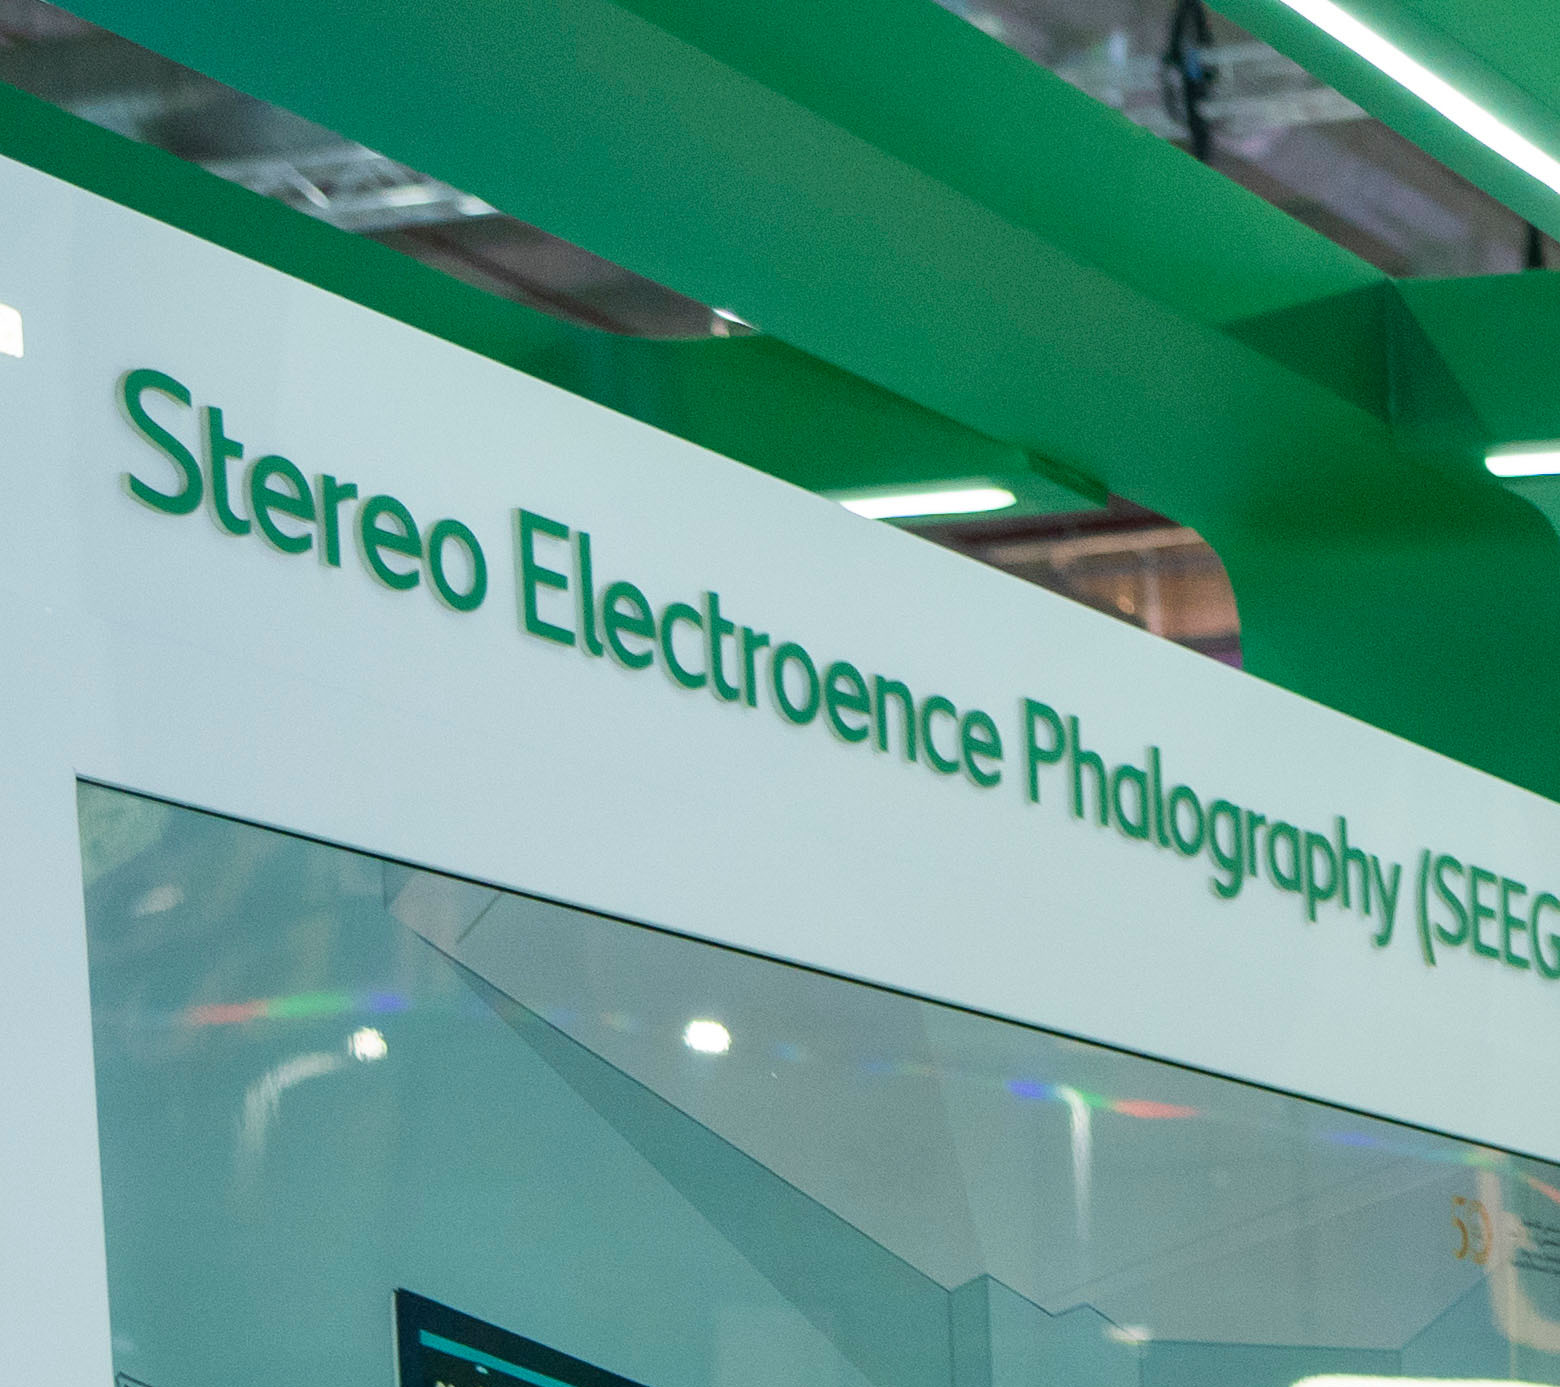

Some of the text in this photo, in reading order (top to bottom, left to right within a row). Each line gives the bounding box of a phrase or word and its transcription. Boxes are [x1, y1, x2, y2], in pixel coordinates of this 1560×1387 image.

[120, 366, 488, 614] Stereo
[513, 507, 1003, 790] Electroence
[1022, 699, 1403, 948] Phalography
